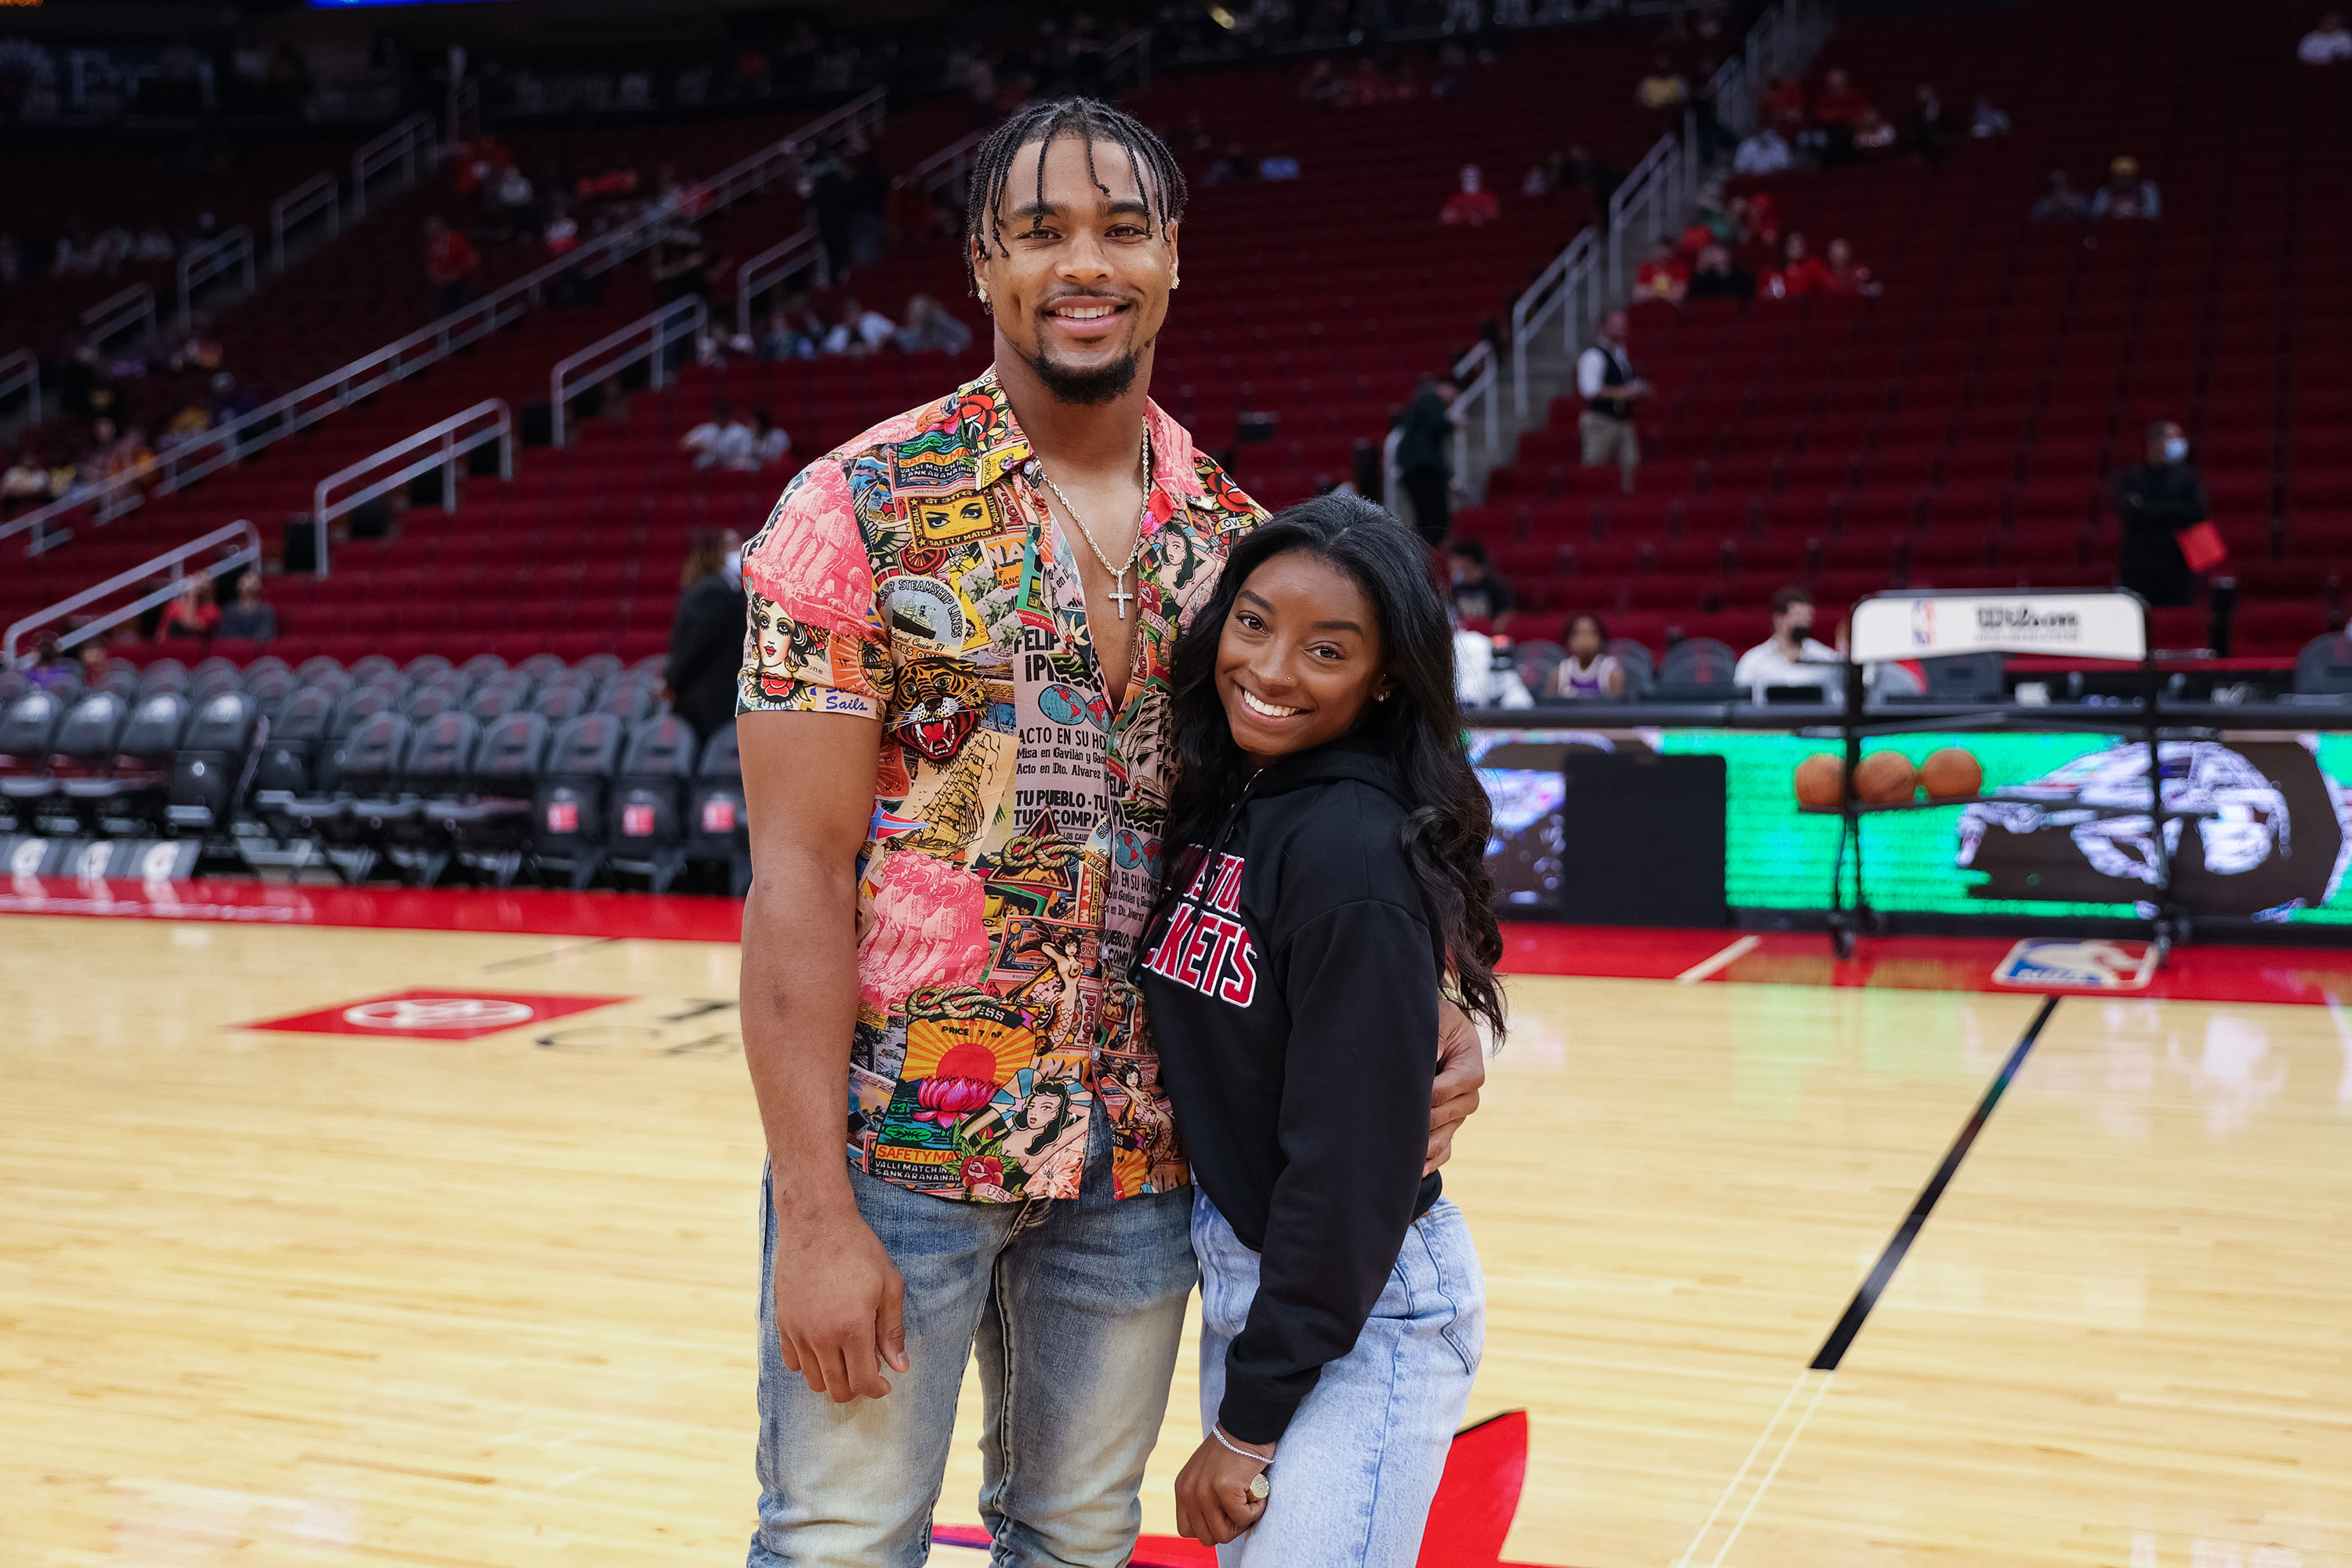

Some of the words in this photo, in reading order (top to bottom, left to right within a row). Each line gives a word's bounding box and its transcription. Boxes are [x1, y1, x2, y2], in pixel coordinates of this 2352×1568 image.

[901, 452, 949, 466] SAFETY
[900, 464, 923, 474] VALLI
[925, 463, 955, 473] MATCH
[986, 495, 1000, 523] QUALITY
[912, 508, 923, 536] SPECIAL
[1218, 517, 1246, 530] LOVE
[929, 536, 963, 546] SAFETY
[964, 529, 992, 541] MATCH
[898, 579, 954, 605] STEAMSHIP
[947, 604, 963, 638] LINES
[1149, 612, 1170, 637] USA
[912, 637, 932, 650] Cruise
[826, 695, 869, 711] Sails
[1018, 727, 1052, 745] ACTO
[1057, 728, 1071, 745] EN
[1075, 730, 1089, 747] SU
[1092, 732, 1108, 750] HO
[1016, 748, 1037, 760] Misa
[1040, 749, 1051, 758] en
[1053, 747, 1083, 760] Gavilán
[1086, 753, 1091, 764] y
[1016, 764, 1036, 775] Acto
[1040, 764, 1050, 774] en
[1052, 762, 1068, 775] Dto.
[1071, 764, 1102, 779] Alvarez
[1015, 789, 1034, 807] TU
[1036, 789, 1086, 808] PUEBLO
[1131, 874, 1139, 891] SU
[941, 1025, 969, 1036] PRICE
[877, 1145, 933, 1162] SAFETY
[875, 1160, 900, 1170] VALLI
[902, 1163, 939, 1174] MATCH
[986, 1184, 1014, 1203] USA
